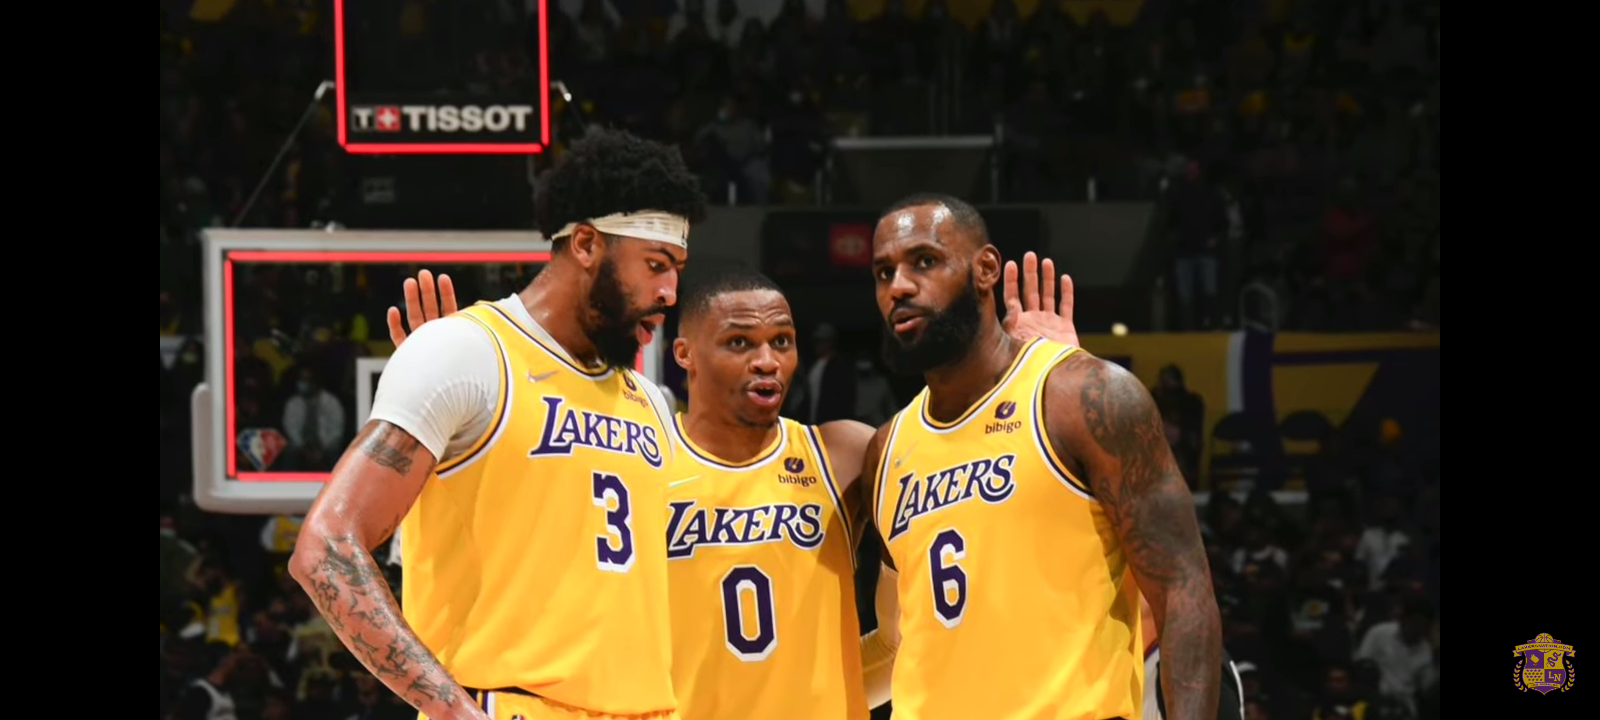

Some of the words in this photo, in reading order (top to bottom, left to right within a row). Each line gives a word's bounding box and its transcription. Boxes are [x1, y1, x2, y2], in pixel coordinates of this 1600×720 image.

[402, 106, 532, 132] TISSOT
[528, 395, 663, 469] LAKERS
[985, 420, 1022, 435] bibigo
[777, 474, 818, 487] bibigo
[887, 454, 1017, 542] LAKERS
[592, 470, 635, 573] 3
[666, 499, 826, 560] LAKERS
[720, 564, 778, 662] 0
[928, 528, 968, 629] 6
